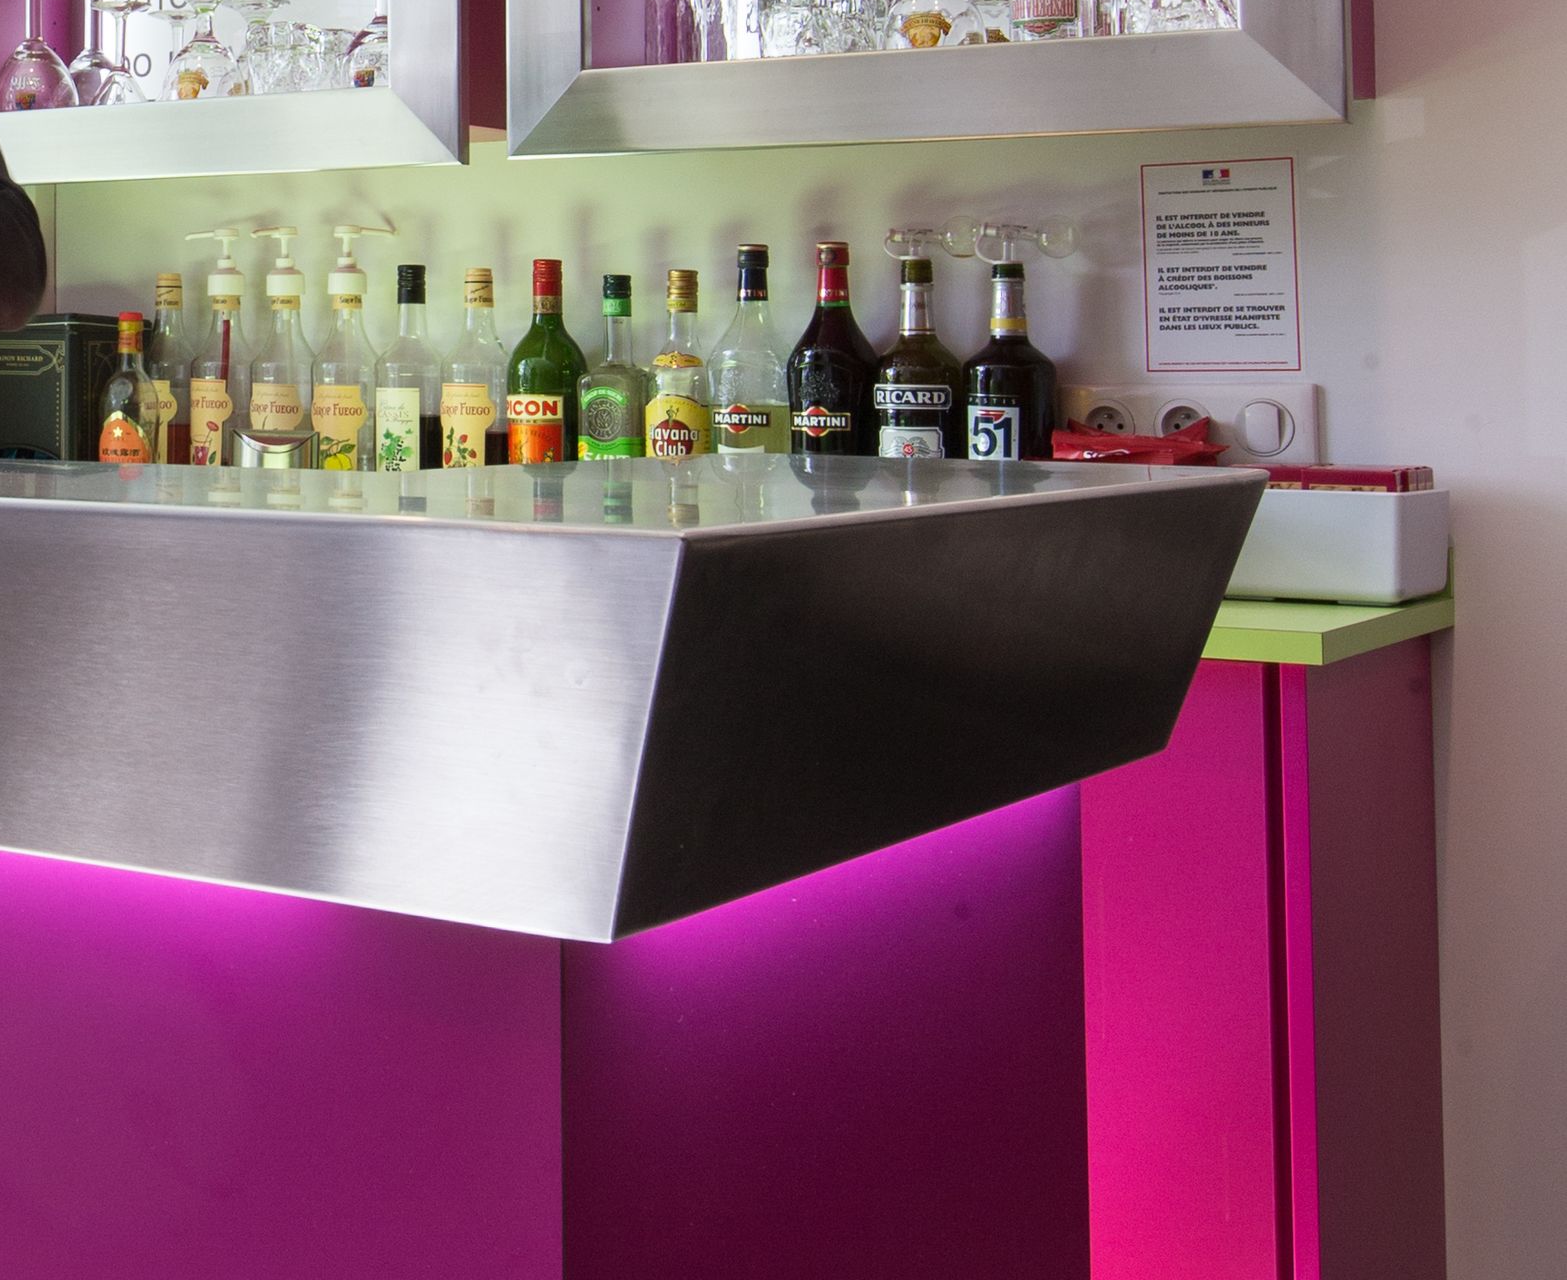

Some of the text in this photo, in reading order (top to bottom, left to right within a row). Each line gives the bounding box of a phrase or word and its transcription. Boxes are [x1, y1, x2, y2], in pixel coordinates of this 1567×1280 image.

[1208, 220, 1214, 228] À
[876, 390, 946, 404] RICARD
[968, 397, 1017, 406] PASTIS
[714, 412, 768, 425] MARTINI
[793, 414, 846, 427] MARTINI
[649, 424, 699, 442] Havana
[971, 415, 1012, 458] 51
[655, 440, 687, 456] Club
